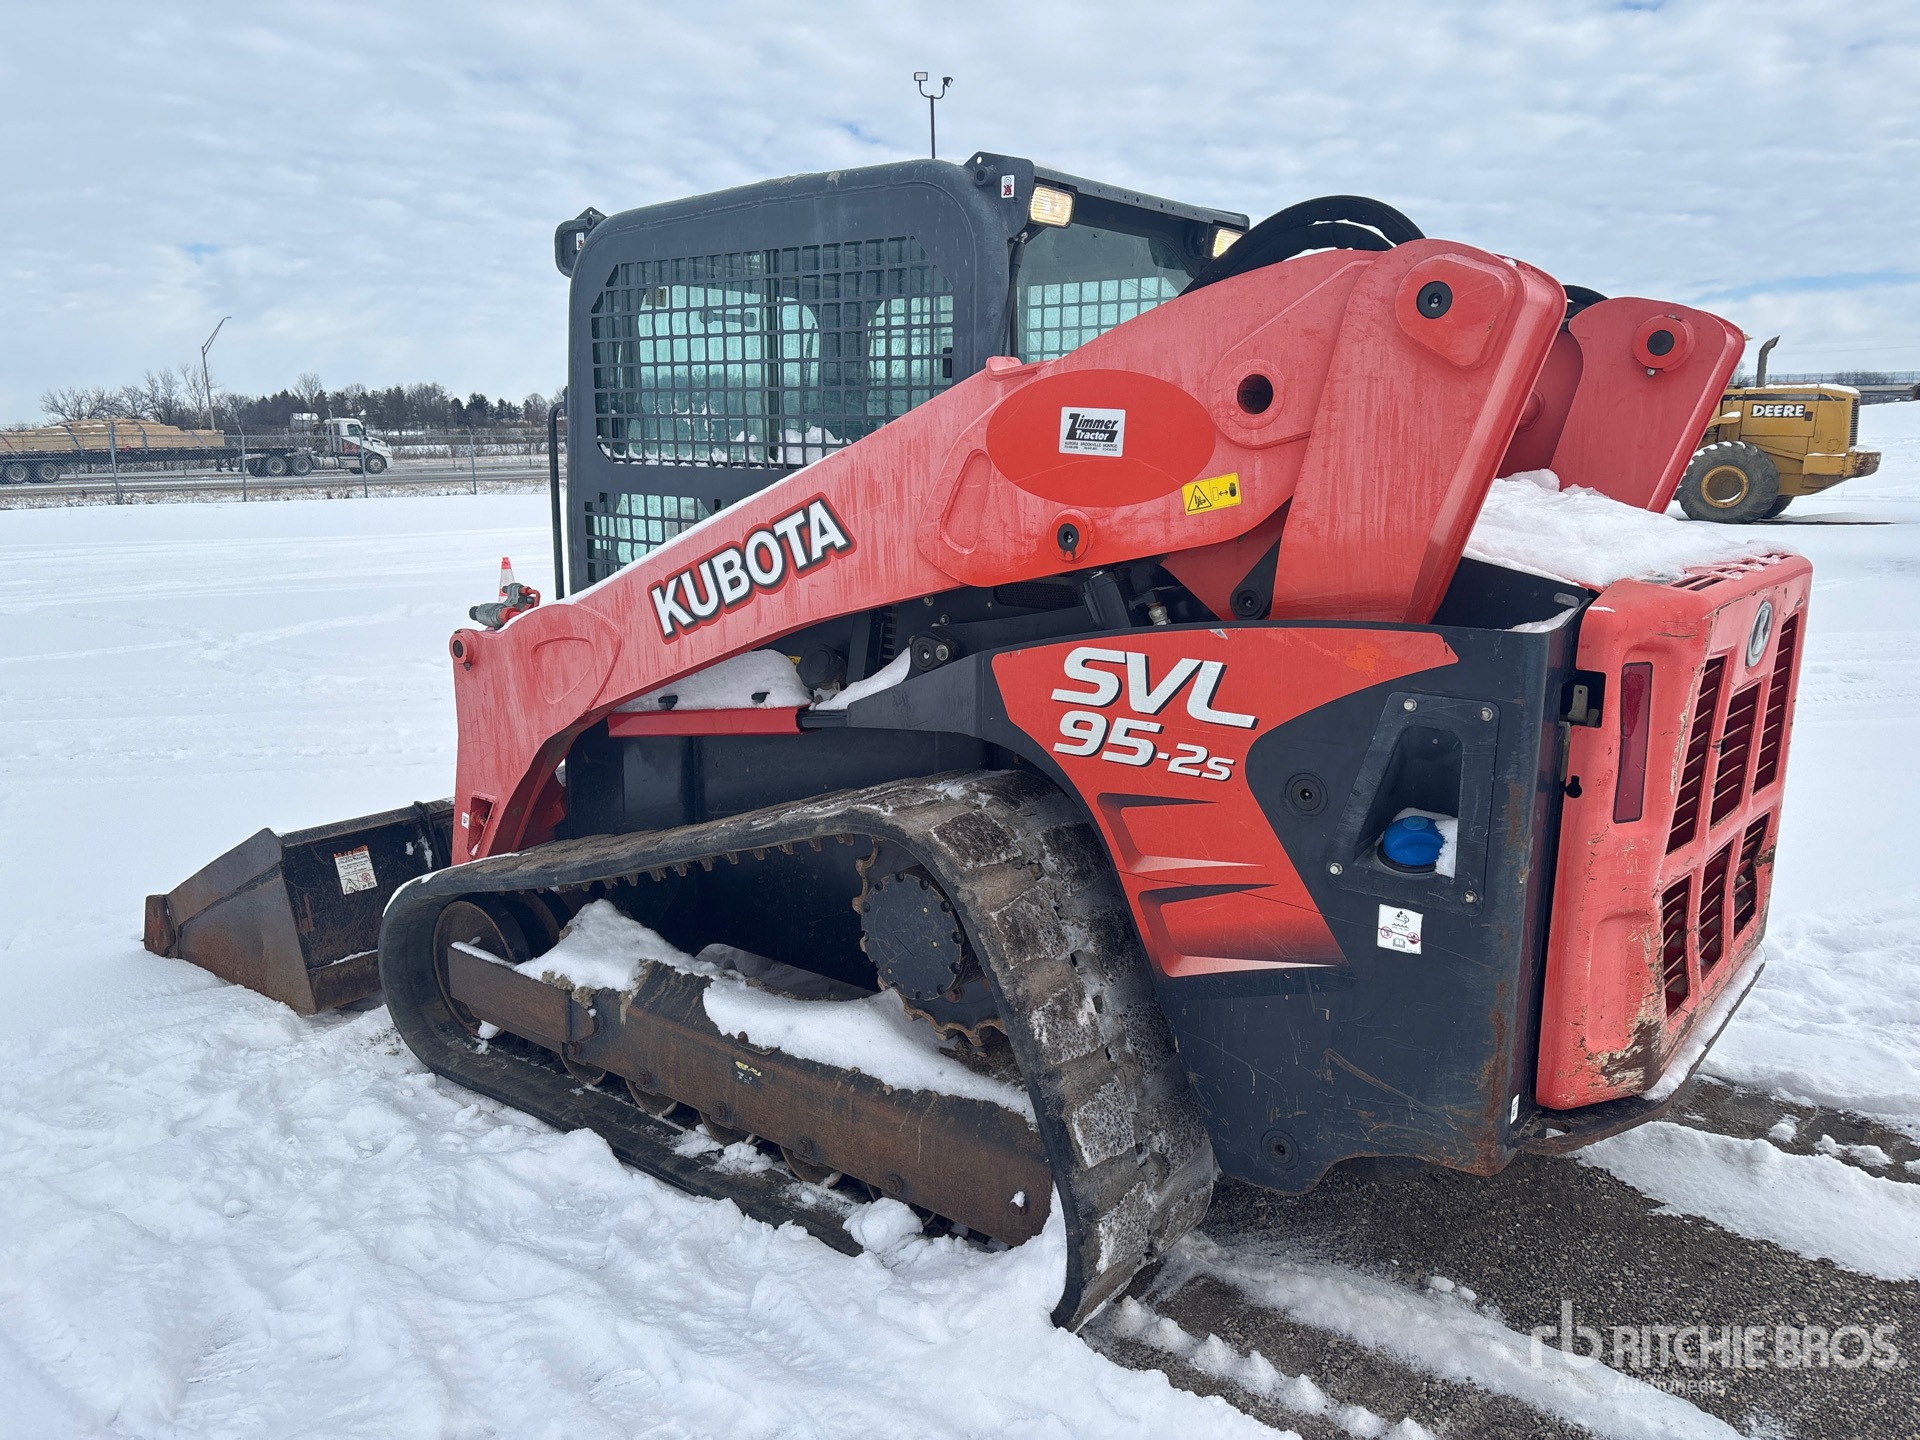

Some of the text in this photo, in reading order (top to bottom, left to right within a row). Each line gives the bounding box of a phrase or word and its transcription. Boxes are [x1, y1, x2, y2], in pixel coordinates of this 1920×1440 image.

[1752, 404, 1805, 418] DEERE
[1066, 413, 1119, 440] Zimmer
[1075, 429, 1110, 441] Tractor
[651, 500, 850, 637] KUBOTA
[1050, 646, 1259, 730] SVL
